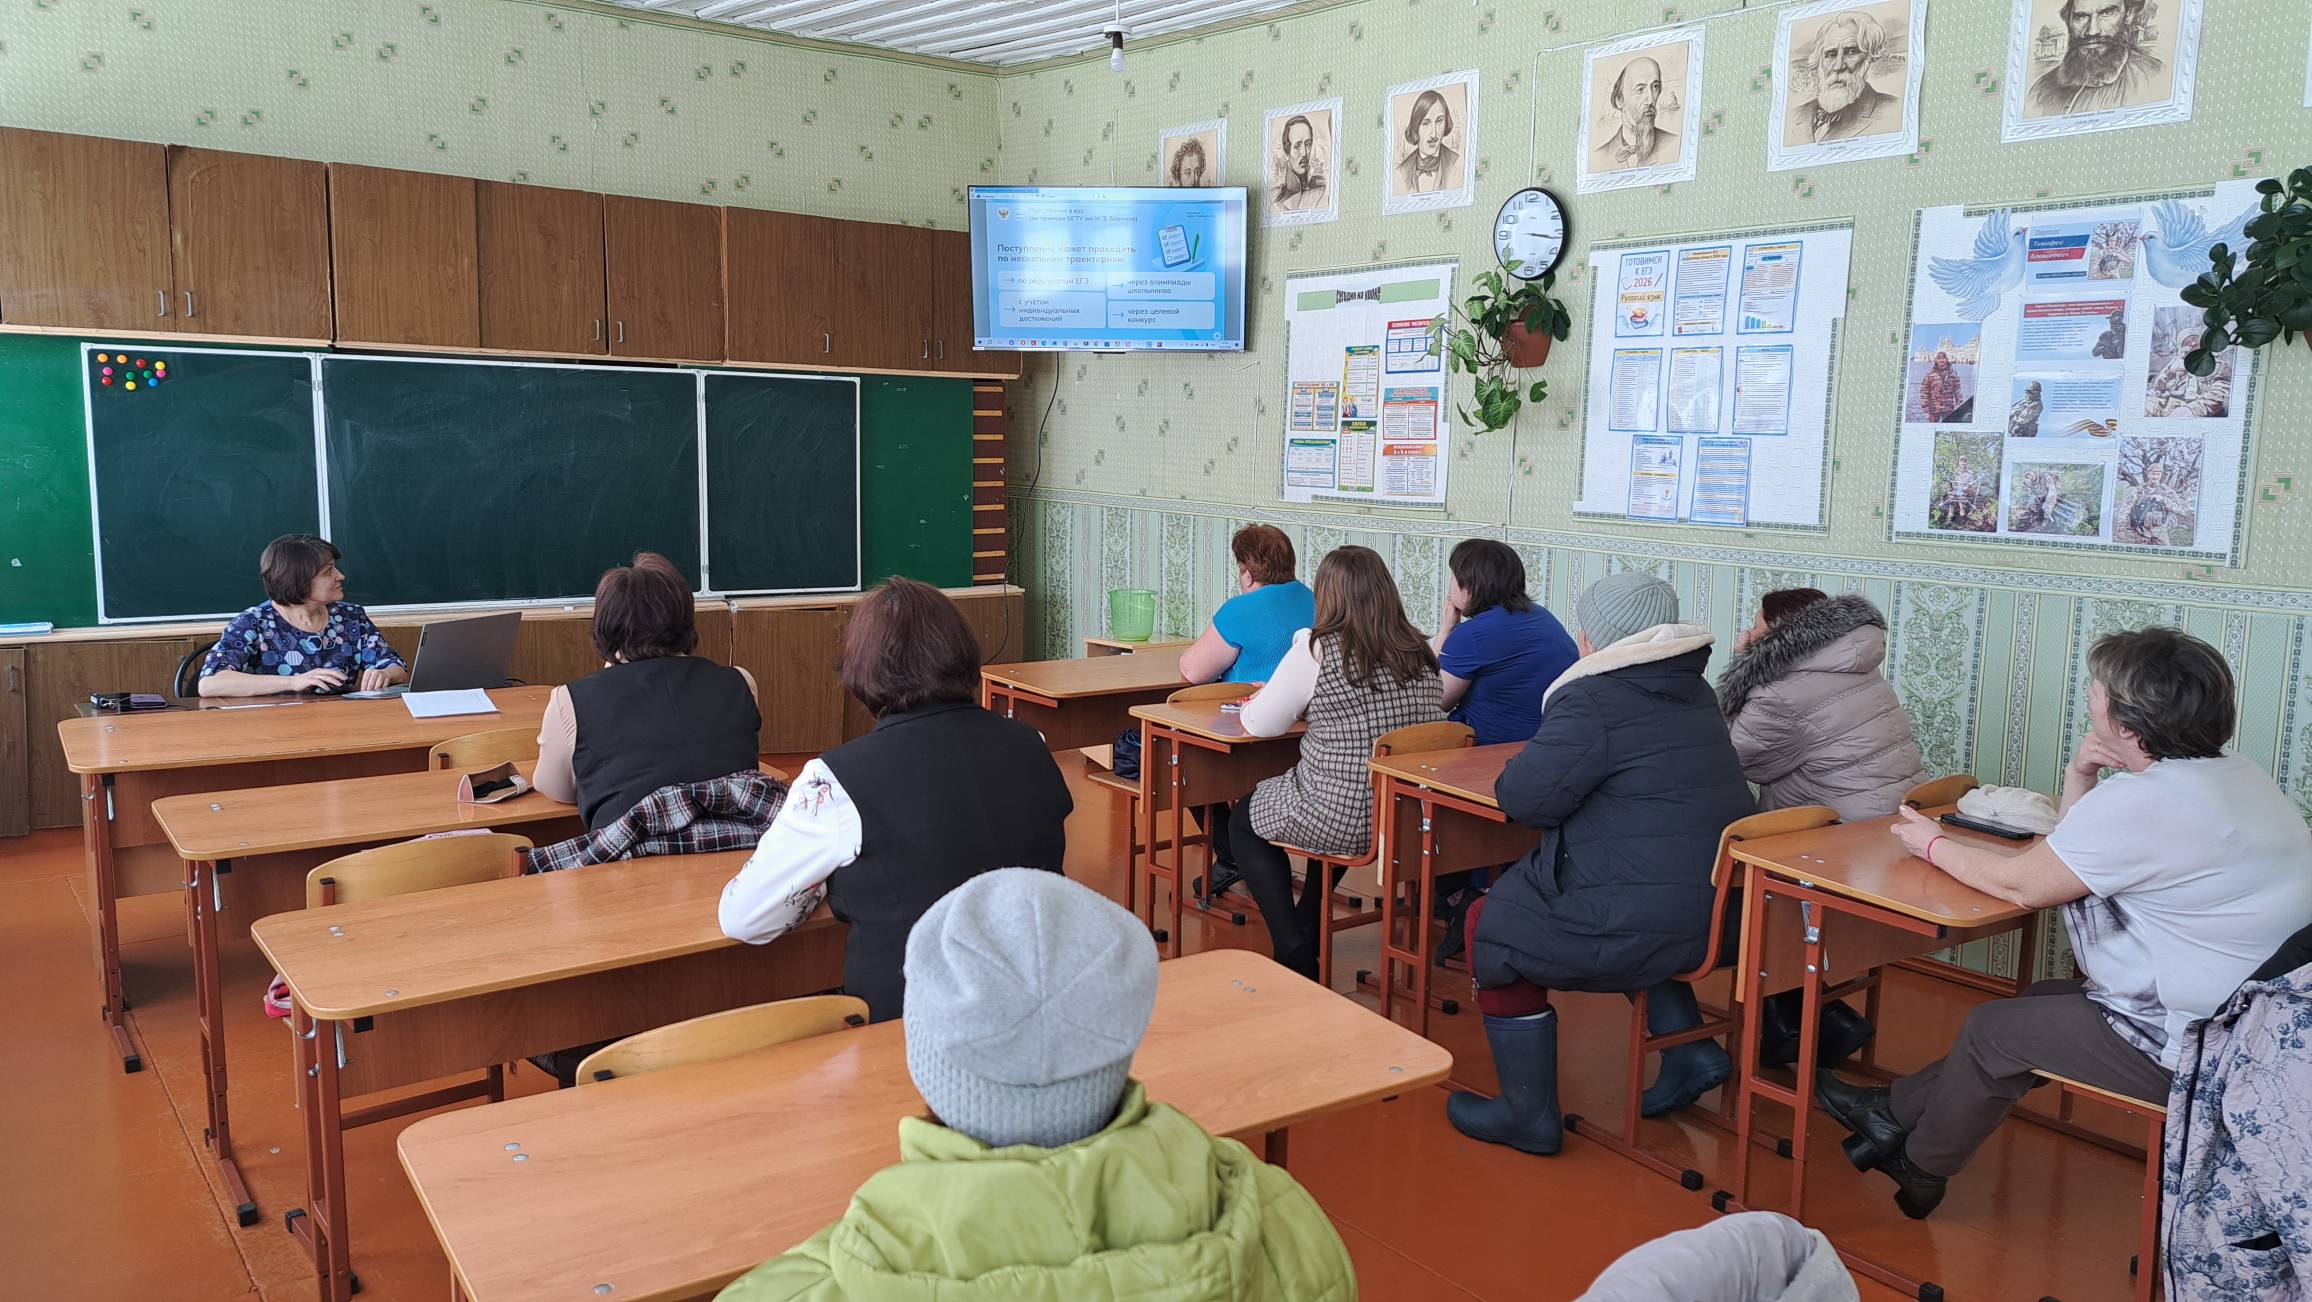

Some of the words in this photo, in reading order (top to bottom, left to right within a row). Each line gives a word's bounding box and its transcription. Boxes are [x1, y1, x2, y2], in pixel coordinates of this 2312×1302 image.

[1525, 192, 1541, 203] 12
[1513, 201, 1524, 210] 11
[1502, 214, 1518, 224] 10
[1550, 210, 1561, 220] 2
[1499, 230, 1511, 241] 9
[1554, 228, 1562, 239] 3
[1088, 245, 1136, 253] проходить
[1539, 260, 1549, 270] 5
[1625, 256, 1662, 266] ГОТОВИМСЯ
[1523, 266, 1534, 276] 6
[1635, 267, 1640, 275] К
[1641, 267, 1652, 275] ЕГЭ
[1633, 277, 1653, 288] 2026
[1150, 308, 1179, 316] целевой
